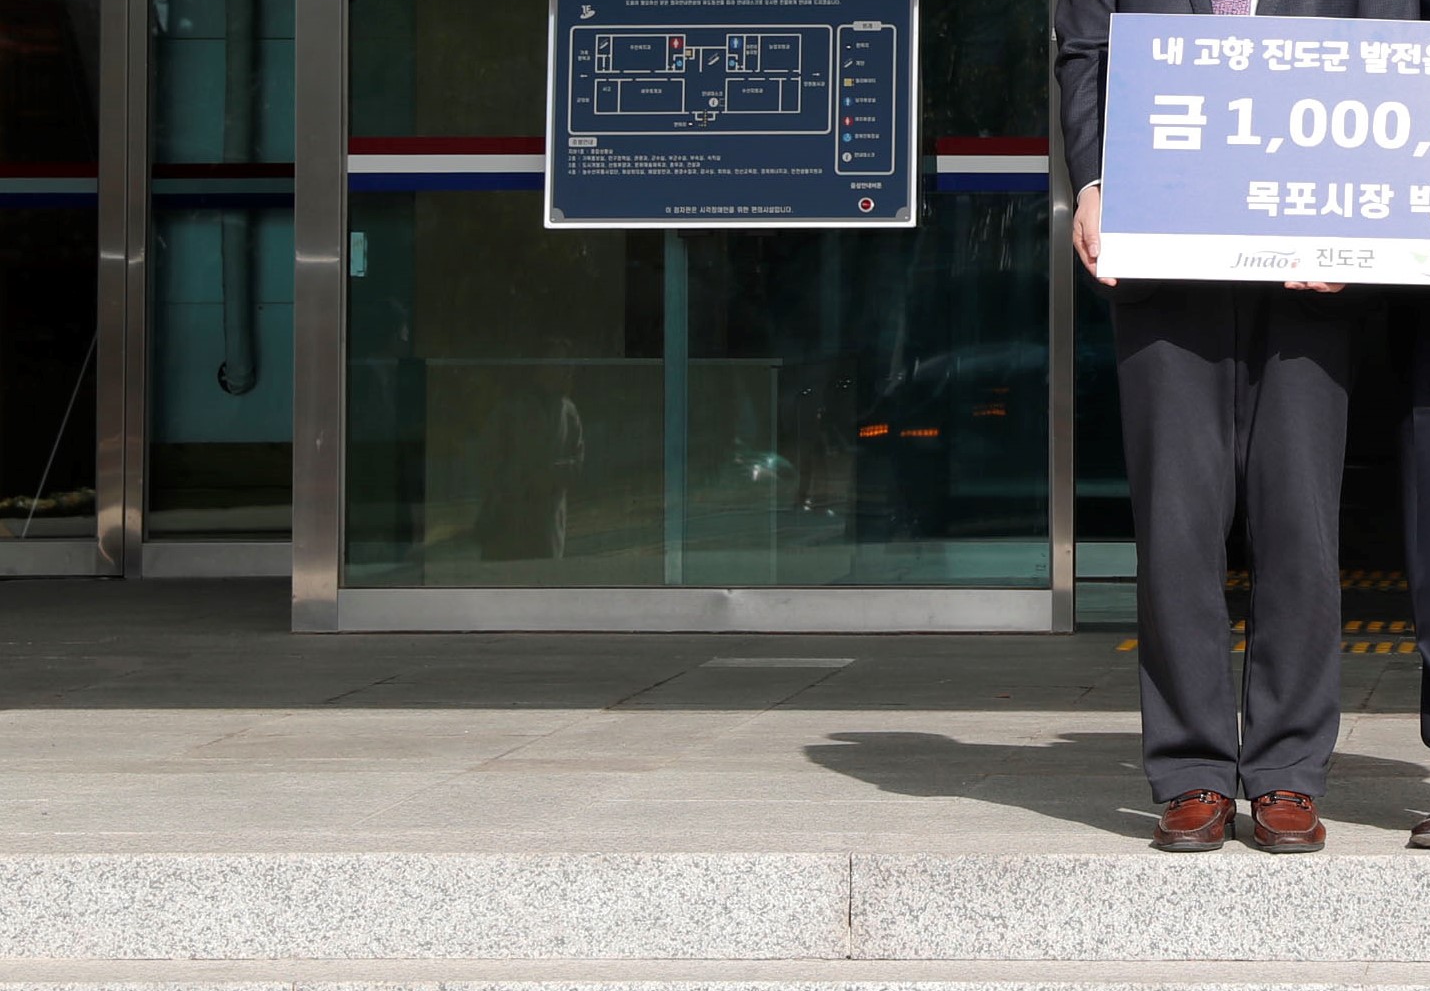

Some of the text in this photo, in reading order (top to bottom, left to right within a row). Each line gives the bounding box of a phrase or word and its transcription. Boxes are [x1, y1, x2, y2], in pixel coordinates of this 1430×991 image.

[1152, 37, 1184, 66] 내
[1193, 36, 1254, 71] 고향
[1262, 39, 1350, 73] 진도군
[1149, 95, 1207, 150] 금
[1246, 181, 1395, 219] 목포시장
[1316, 248, 1376, 269] 진도군
